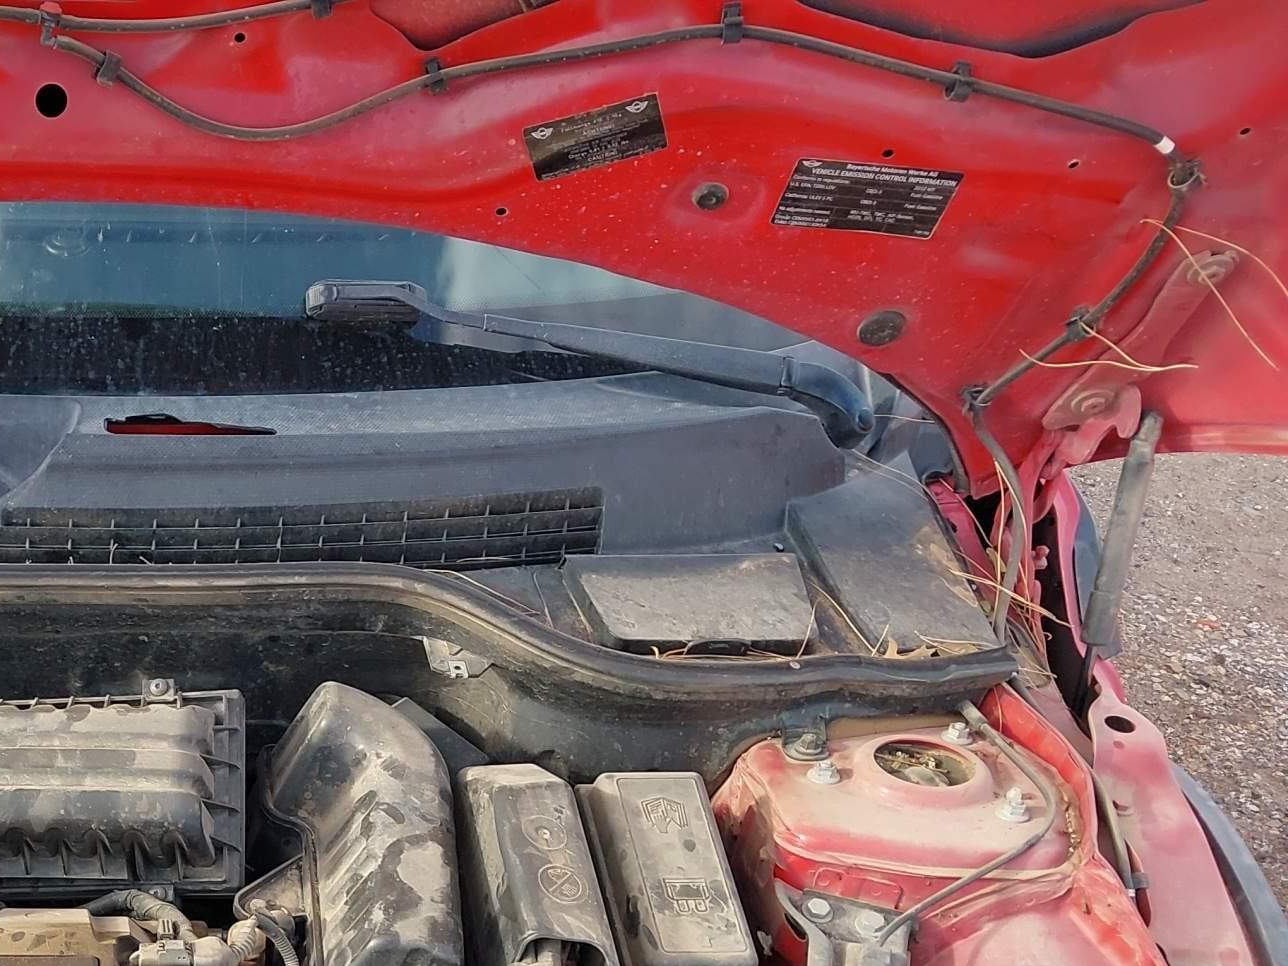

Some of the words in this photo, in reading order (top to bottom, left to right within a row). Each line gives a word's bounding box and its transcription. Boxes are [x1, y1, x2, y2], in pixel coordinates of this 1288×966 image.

[811, 167, 840, 177] VEHICLE
[840, 169, 874, 180] EMISSION
[875, 173, 908, 183] CONTROL
[908, 175, 958, 187] INFORMATION
